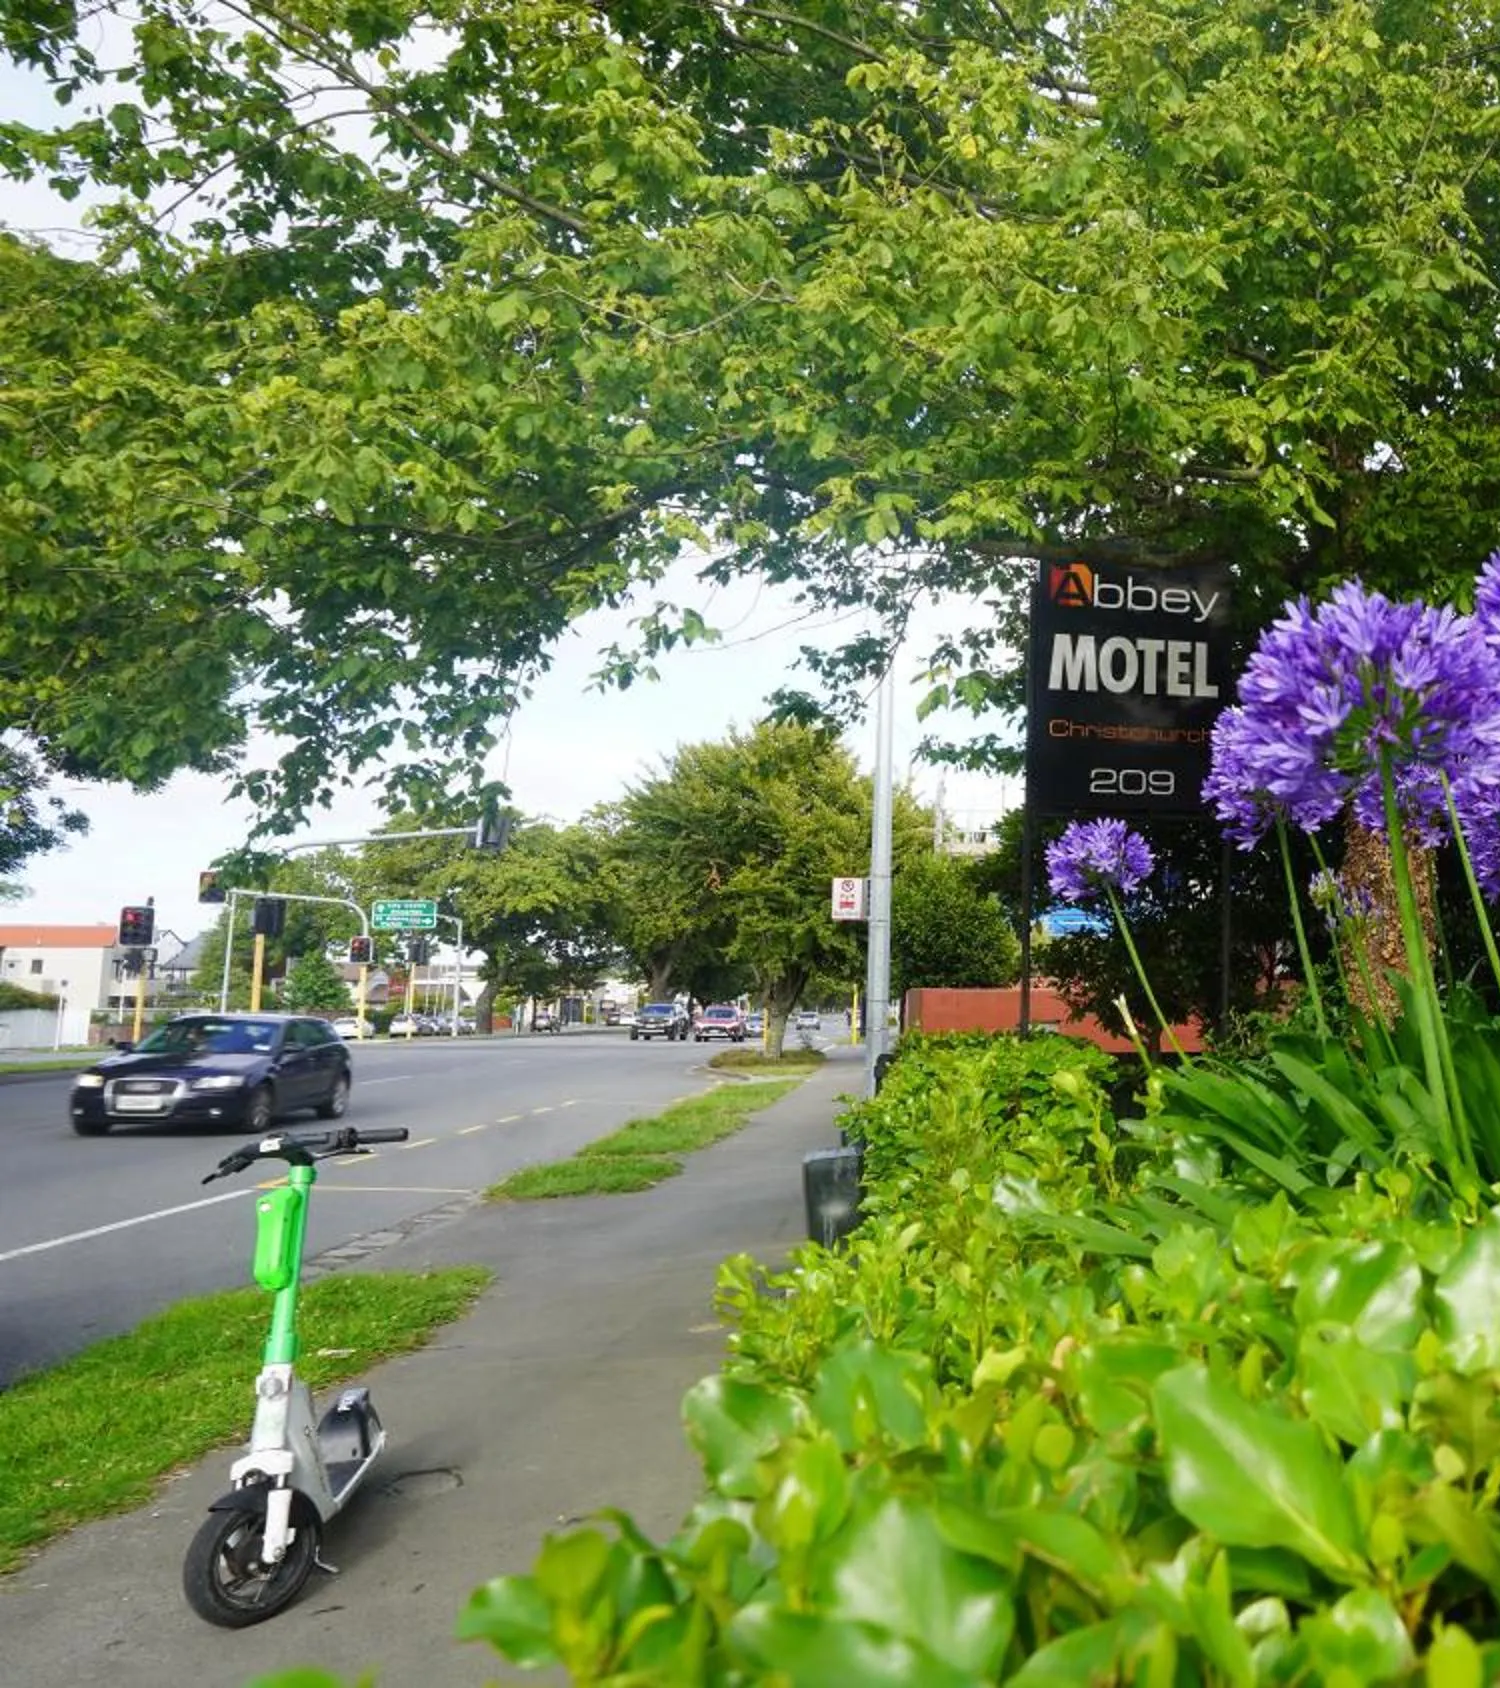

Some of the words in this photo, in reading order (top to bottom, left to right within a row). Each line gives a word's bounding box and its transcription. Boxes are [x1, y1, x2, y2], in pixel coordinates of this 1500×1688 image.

[1051, 564, 1219, 622] Abbey
[1048, 633, 1219, 698] MOTEL
[1089, 768, 1175, 795] 209
